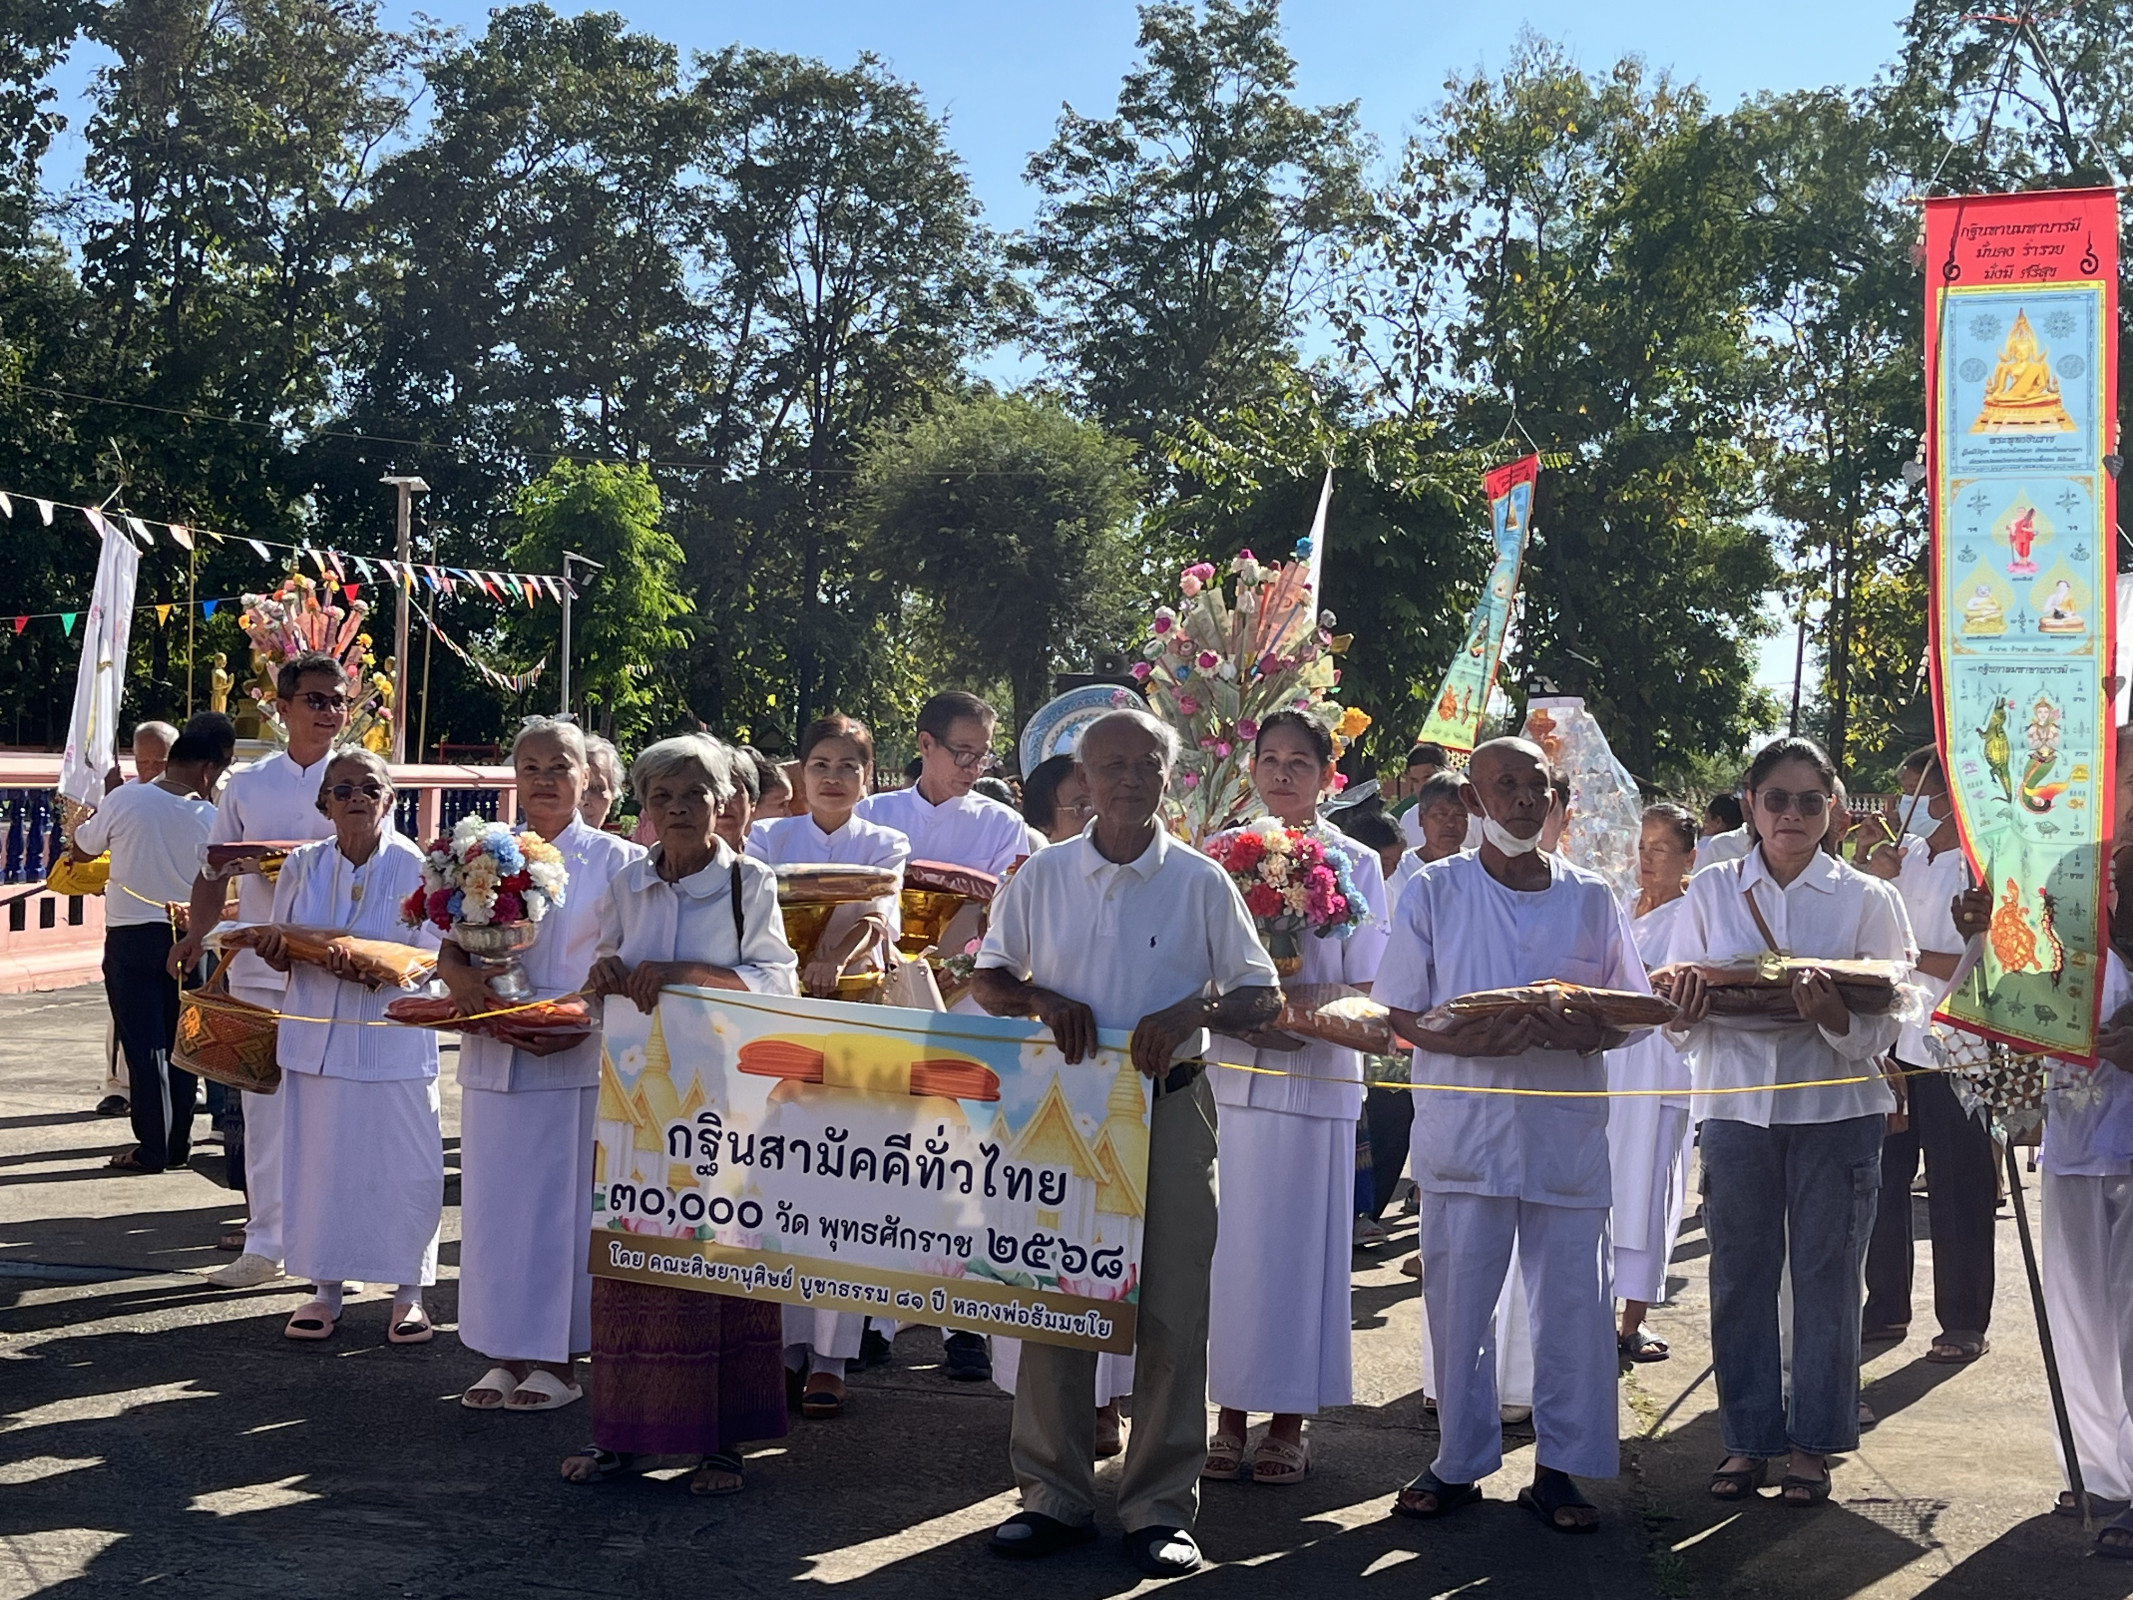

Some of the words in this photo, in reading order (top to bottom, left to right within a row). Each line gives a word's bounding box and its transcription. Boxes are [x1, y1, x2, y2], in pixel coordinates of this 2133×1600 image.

[667, 1111, 1067, 1206] กฐินสามัคคีทั่วไทย
[609, 1183, 763, 1230] ๓๐,๐๐๐
[775, 1200, 809, 1236] วัด
[818, 1214, 973, 1258] พุทธศักราช
[986, 1227, 1125, 1280] ๒๕๖๘
[610, 1243, 643, 1268] โดย
[650, 1256, 793, 1290] คณะศิษยานุศิษย์
[800, 1277, 889, 1303] บูชาธรรม
[896, 1291, 925, 1309] ๘๑
[931, 1290, 945, 1312] ปี
[952, 1299, 1114, 1338] หลวงพ่อธัมมชโย
